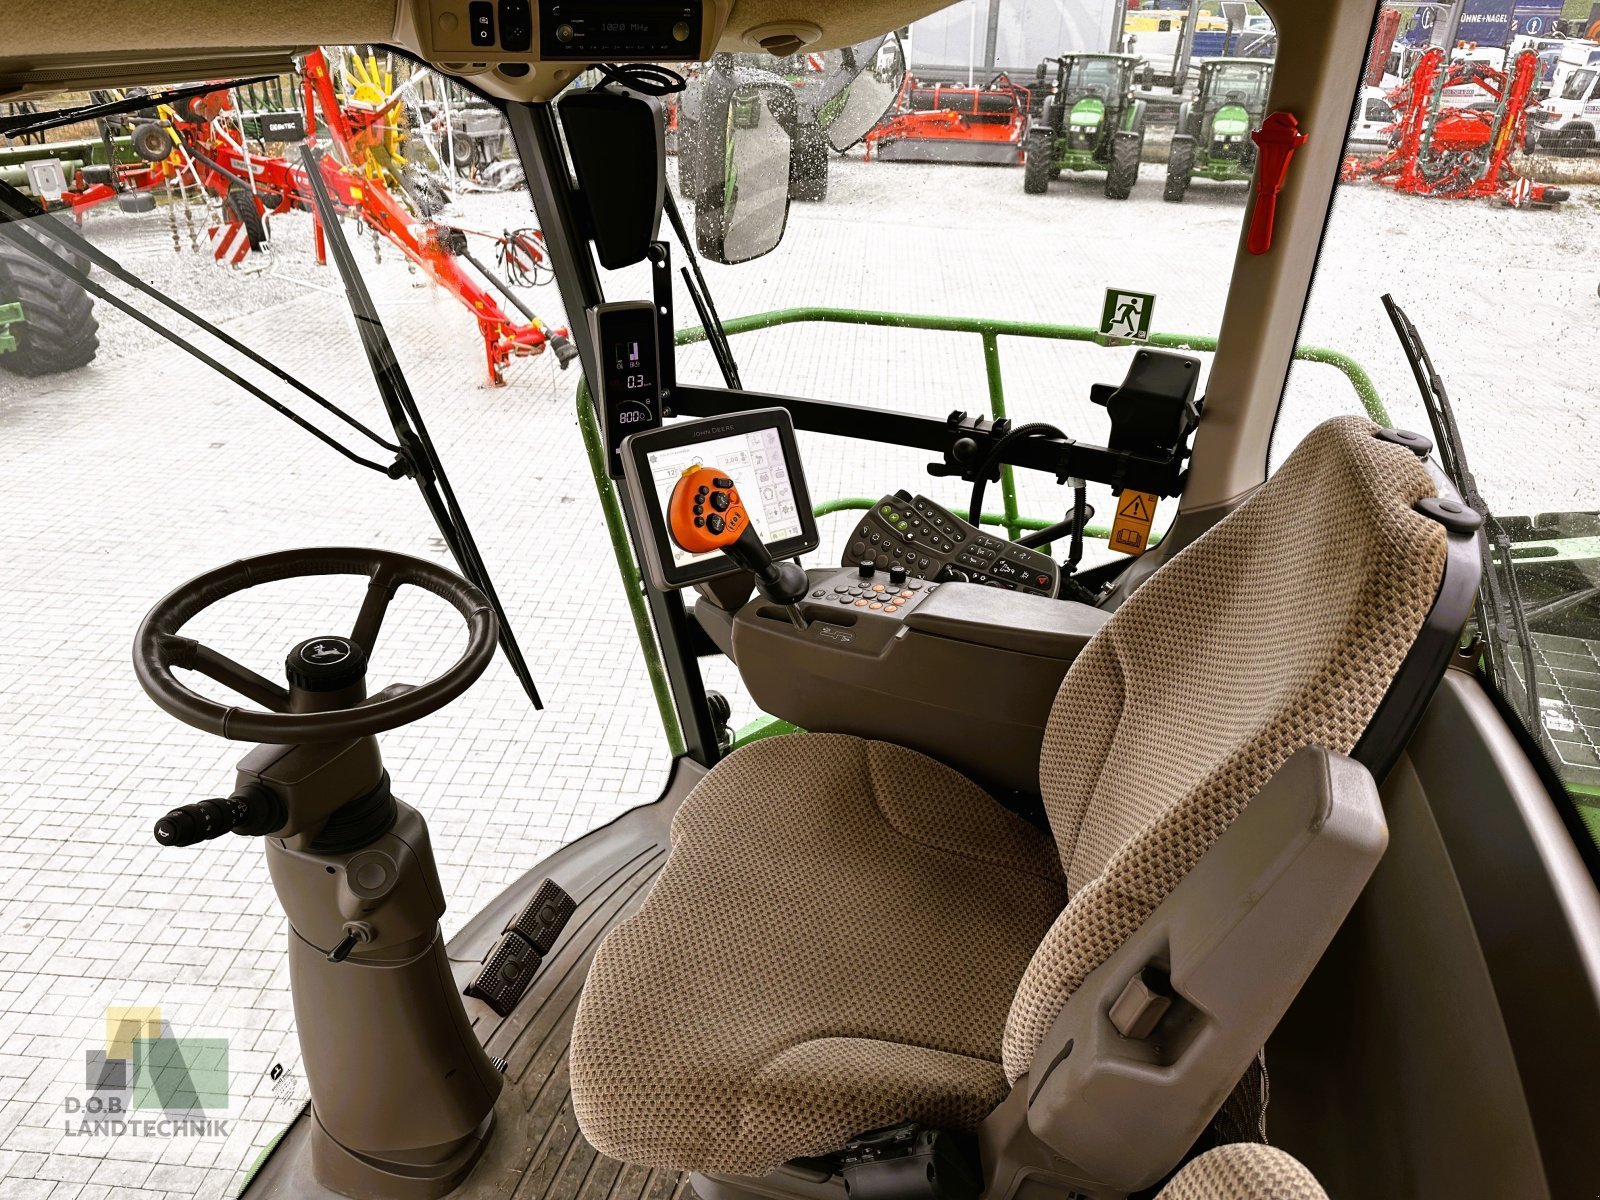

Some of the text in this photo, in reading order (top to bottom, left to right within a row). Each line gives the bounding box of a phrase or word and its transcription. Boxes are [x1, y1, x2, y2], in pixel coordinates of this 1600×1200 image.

[1460, 12, 1508, 23] ÜHNE+NAGEL
[627, 374, 644, 389] 0.3
[619, 410, 640, 424] 800
[693, 424, 735, 438] JOHN DEERE
